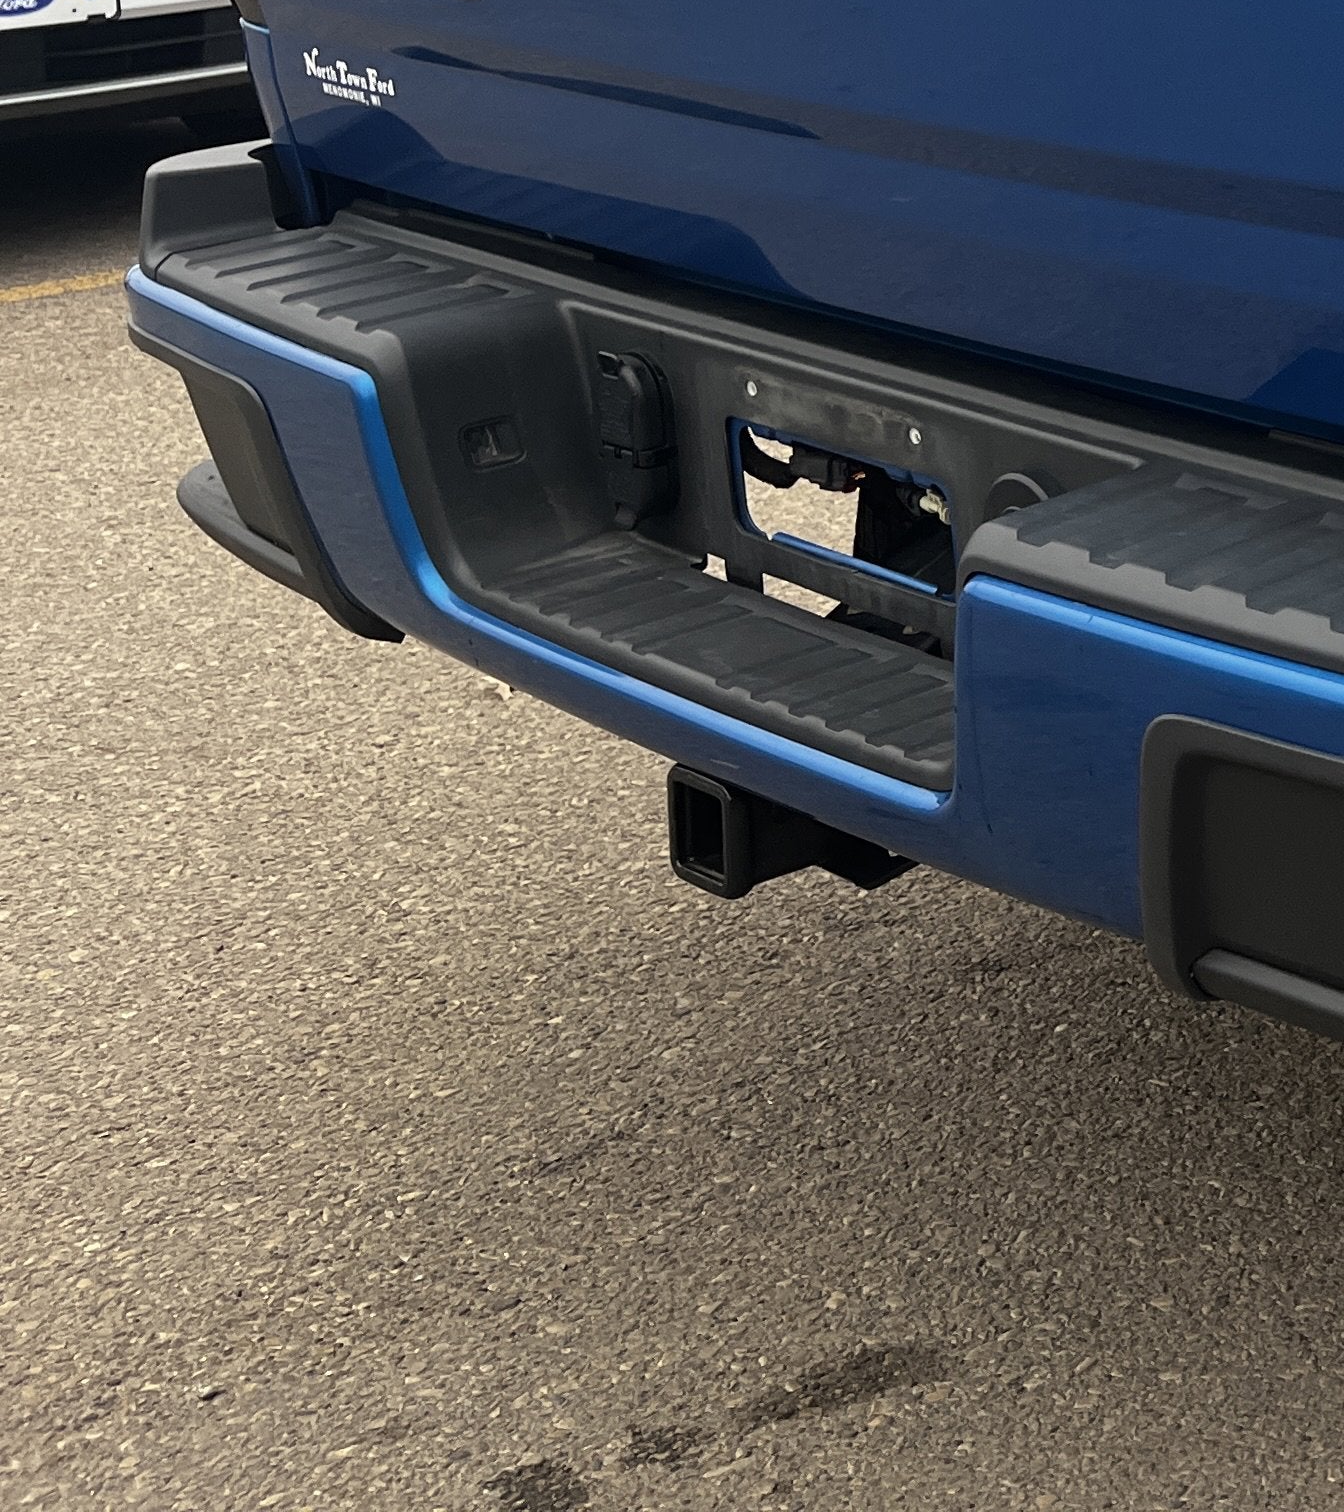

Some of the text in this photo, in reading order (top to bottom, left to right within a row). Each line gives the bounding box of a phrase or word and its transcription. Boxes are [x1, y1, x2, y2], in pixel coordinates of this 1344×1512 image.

[303, 47, 395, 97] North Town Ford
